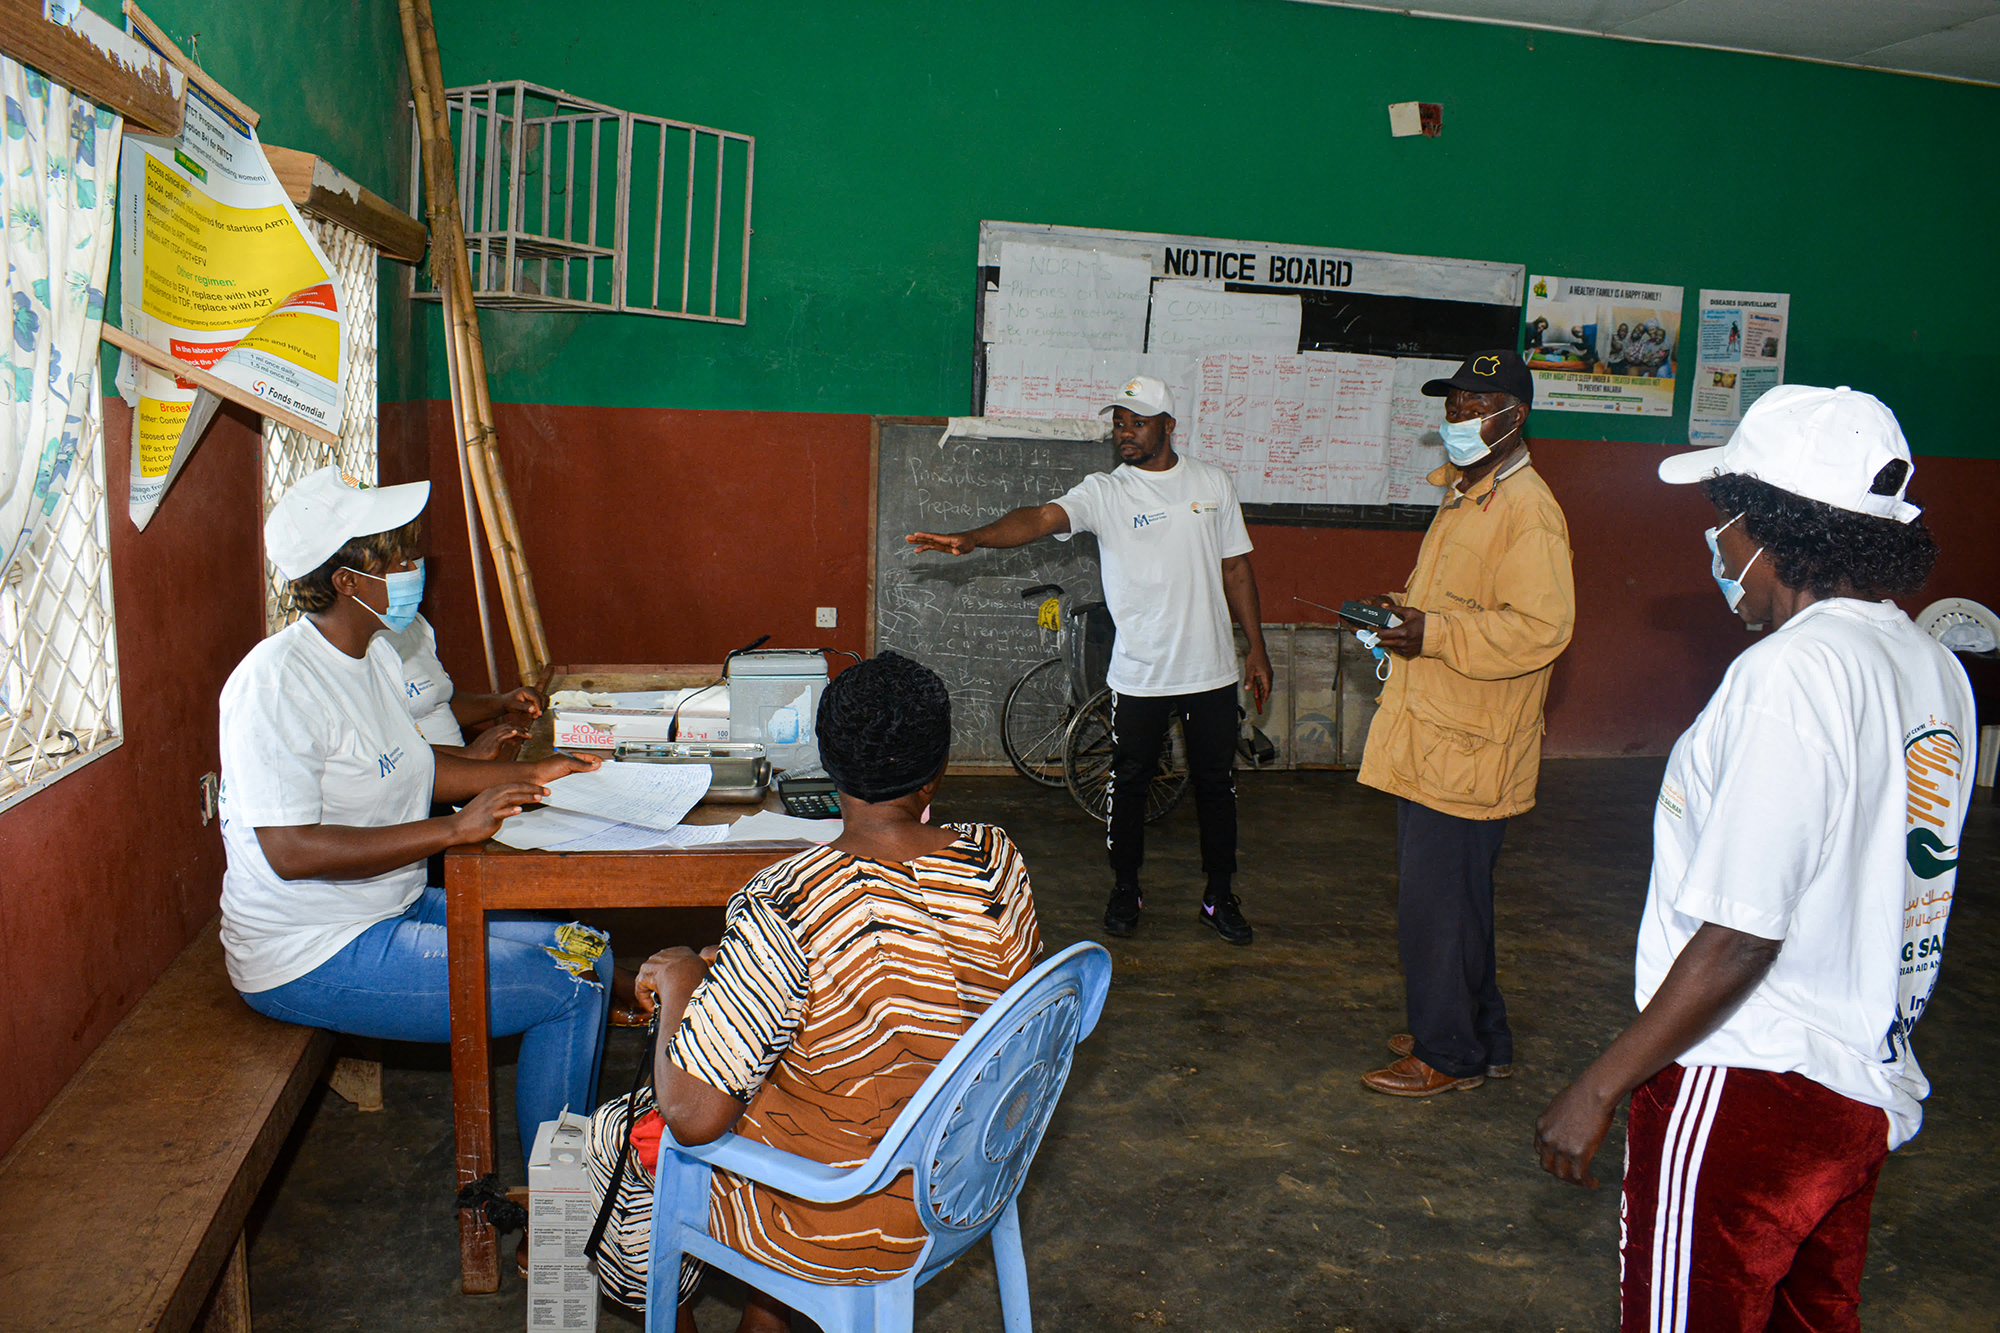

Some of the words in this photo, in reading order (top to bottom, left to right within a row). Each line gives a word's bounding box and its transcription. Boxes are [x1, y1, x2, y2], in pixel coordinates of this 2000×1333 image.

[198, 113, 225, 140] Programme
[147, 159, 164, 179] Access
[238, 174, 266, 182] women)
[215, 219, 225, 230] for
[226, 223, 264, 233] starting
[1030, 256, 1113, 281] NORMS
[1164, 247, 1256, 281] NOTICE
[1269, 255, 1353, 287] BOARD
[176, 264, 193, 280] Other
[194, 274, 237, 288] regimen:
[192, 290, 223, 301] replace
[224, 291, 246, 301] with
[247, 288, 270, 299] NVP
[1078, 288, 1099, 300] on
[1568, 285, 1574, 296] A
[1573, 286, 1595, 297] HEALTHY
[1595, 287, 1614, 298] FAMILY
[1613, 288, 1620, 299] IS
[1620, 289, 1625, 299] A
[1624, 289, 1641, 300] HAPPY
[193, 302, 228, 313] replace
[229, 301, 252, 311] with
[253, 297, 273, 308] AZT
[1167, 300, 1234, 318] COVID
[1710, 299, 1736, 307] DISEASES
[1737, 300, 1778, 309] SURVEILLANCE
[1035, 304, 1065, 319] side
[1073, 308, 1125, 322] meetings
[183, 318, 209, 327] pregnancy
[175, 344, 182, 352] In
[191, 346, 214, 354] labour
[287, 343, 302, 353] HIV
[303, 349, 318, 361] test
[264, 360, 280, 369] once
[281, 365, 296, 377] daily
[269, 369, 285, 379] once
[285, 373, 300, 387] daily
[1538, 371, 1553, 380] EVERY
[1553, 372, 1567, 382] NIGHT
[1578, 373, 1592, 383] SLEEP
[1592, 374, 1607, 384] UNDER
[1612, 376, 1630, 385] TREATED
[1577, 383, 1584, 391] TO
[1583, 384, 1603, 393] PREVENT
[1603, 385, 1622, 394] MALARIA
[267, 386, 293, 405] Fonds
[292, 399, 326, 420] mondial
[140, 431, 166, 441] Exposed
[166, 432, 182, 441] chil
[141, 454, 158, 463] Start
[1030, 448, 1051, 468] 19
[994, 472, 1011, 493] of
[1022, 475, 1064, 495] PFA
[572, 724, 613, 736] KOJA
[561, 733, 615, 745] SELINGE
[1664, 797, 1682, 815] SALMAN
[1915, 962, 1929, 973] AID
